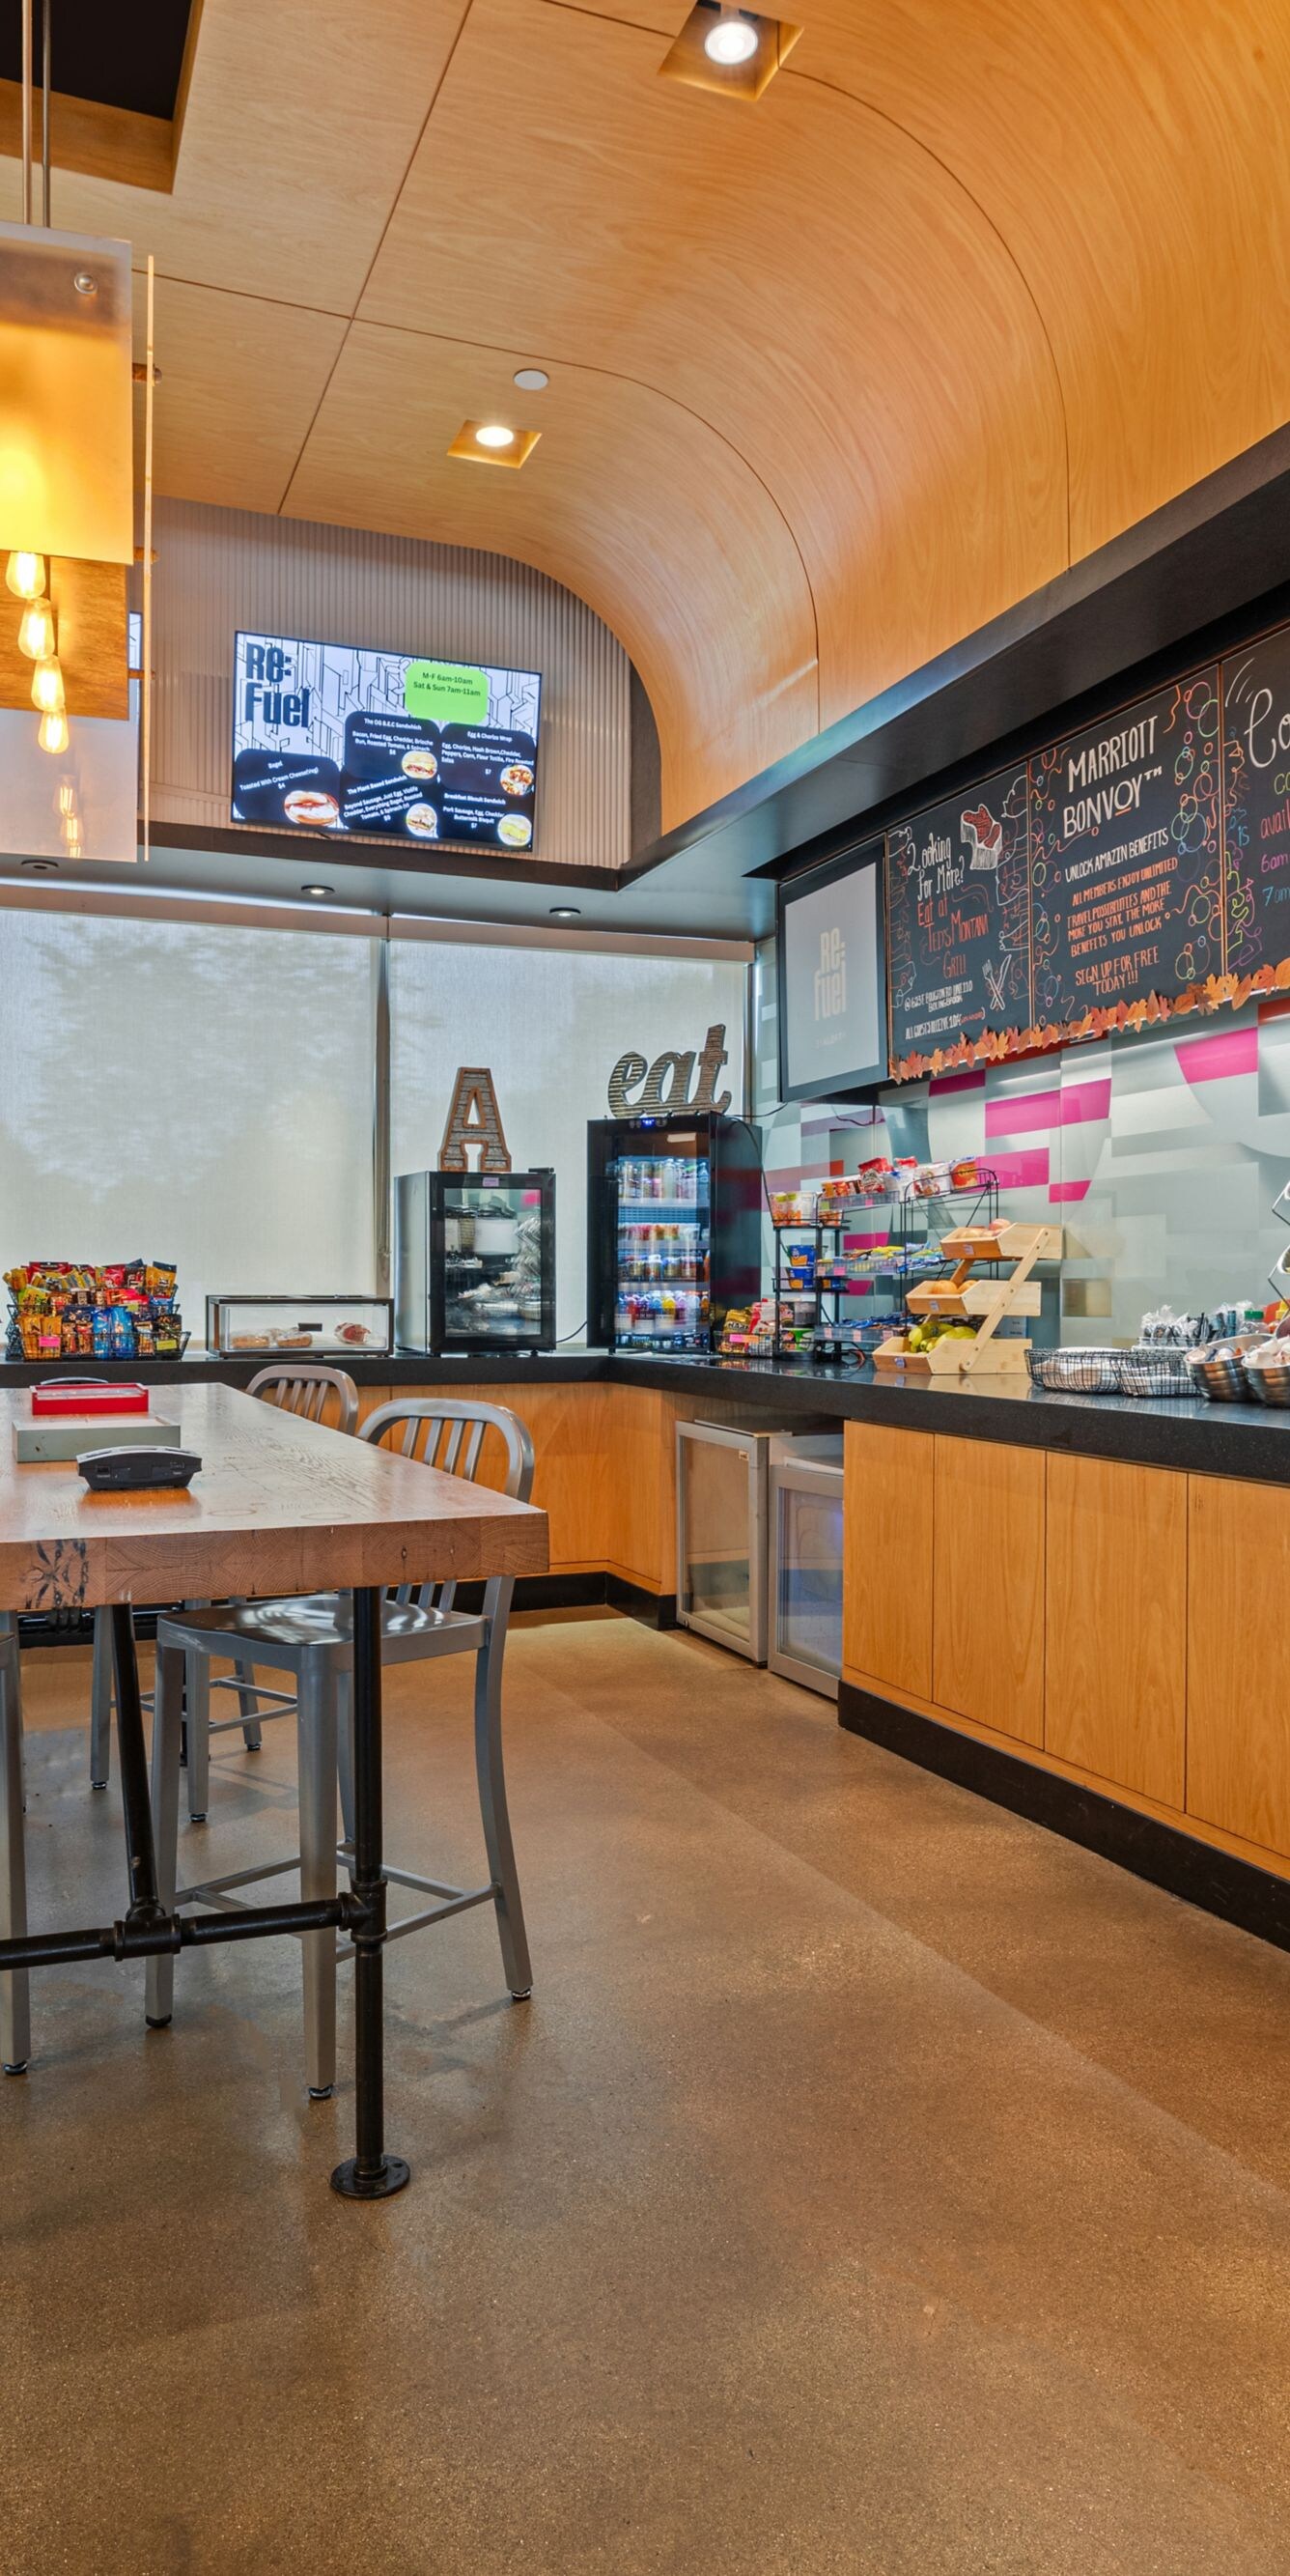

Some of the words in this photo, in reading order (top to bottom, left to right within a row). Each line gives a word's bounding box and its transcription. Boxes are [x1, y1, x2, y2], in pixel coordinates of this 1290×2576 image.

[246, 642, 292, 683] Re:
[437, 673, 473, 685] 6am-10am
[245, 682, 310, 728] Fuel
[447, 685, 481, 696] 7am-11am
[1068, 715, 1158, 793] MARRIOTT
[907, 833, 951, 876] Looking
[936, 855, 965, 893] More?
[1065, 858, 1094, 883] UNLOCK
[1095, 843, 1128, 871] AMAZIN
[1129, 827, 1169, 859] BENEFITS
[1072, 892, 1082, 907] ALL
[1083, 880, 1116, 903] MEMBERS
[1118, 872, 1140, 890] ENJOY
[1140, 857, 1178, 880] UNLIMITED
[1140, 887, 1156, 904] AND
[1156, 880, 1172, 899] THE
[917, 900, 934, 927] Eat
[938, 892, 948, 918] at
[1068, 924, 1085, 942] MORE
[1087, 920, 1103, 935] YOU
[1126, 906, 1140, 921] THE
[1142, 897, 1164, 917] MORE
[1071, 934, 1108, 957] BENEFITS
[1111, 928, 1126, 943] YOU
[1129, 916, 1162, 938] UNLOCK
[1076, 964, 1098, 986] SIGN
[1101, 960, 1112, 977] UP
[1113, 954, 1133, 976] FOR
[1134, 946, 1160, 968] FREE
[607, 1023, 732, 1118] eat
[437, 1066, 512, 1173] A
